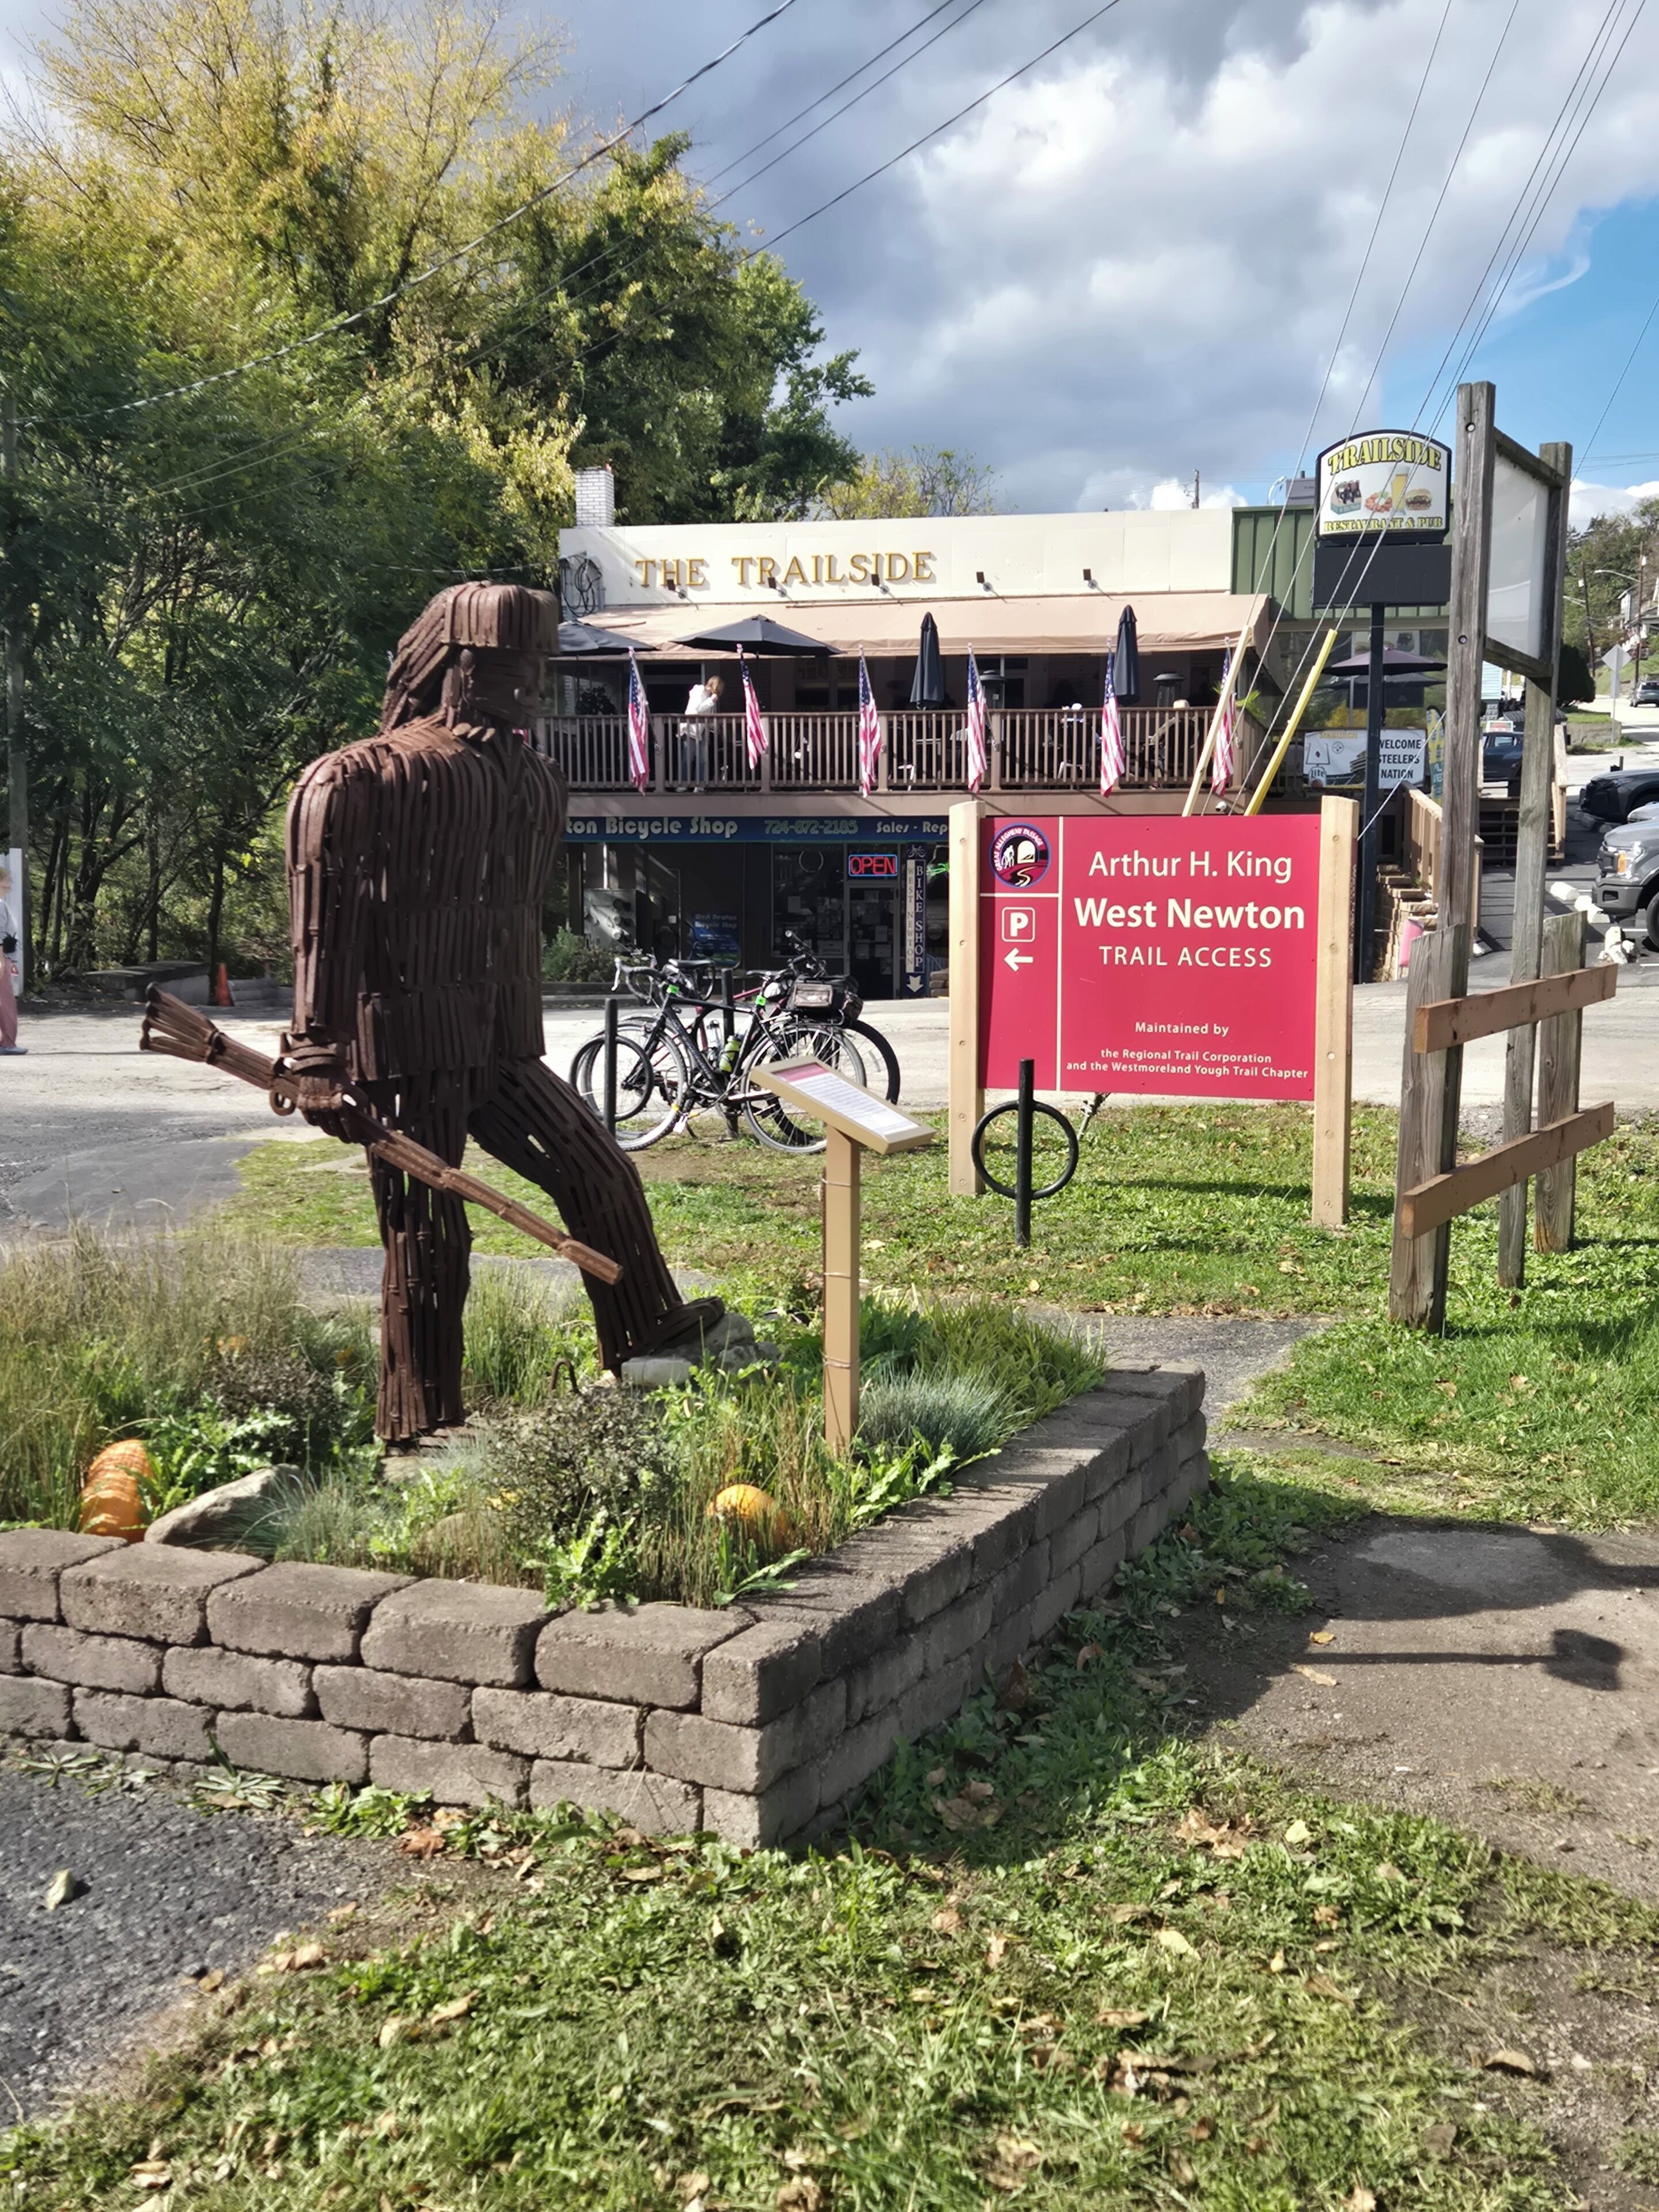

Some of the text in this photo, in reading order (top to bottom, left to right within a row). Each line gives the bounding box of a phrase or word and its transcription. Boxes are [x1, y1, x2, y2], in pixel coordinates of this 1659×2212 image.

[1328, 437, 1441, 475] TRAILSIDE
[1324, 517, 1443, 532] RESTAURANT & PUB
[635, 551, 932, 588] THE TRAILSIDE
[1381, 769, 1414, 779] NATION
[565, 816, 597, 834] ton
[605, 816, 682, 839] Bicycle
[690, 816, 738, 839] Shop
[764, 820, 859, 835] 724-872-2185
[876, 821, 910, 834] Sales
[922, 821, 948, 835] Rep
[849, 856, 896, 875] OPEN
[1088, 850, 1292, 884] Arthur H. King
[907, 867, 915, 903] WEST
[915, 865, 924, 968] BIKE SHOP
[1010, 912, 1029, 937] P
[1074, 897, 1304, 929] West Newton
[1099, 946, 1272, 967] TRAIL ACCESS
[1135, 1021, 1229, 1037] Maintained by
[1101, 1048, 1271, 1063] the Regional Trail Corporation
[1066, 1060, 1308, 1080] and the Westmoreland Yough Trail Chapter
